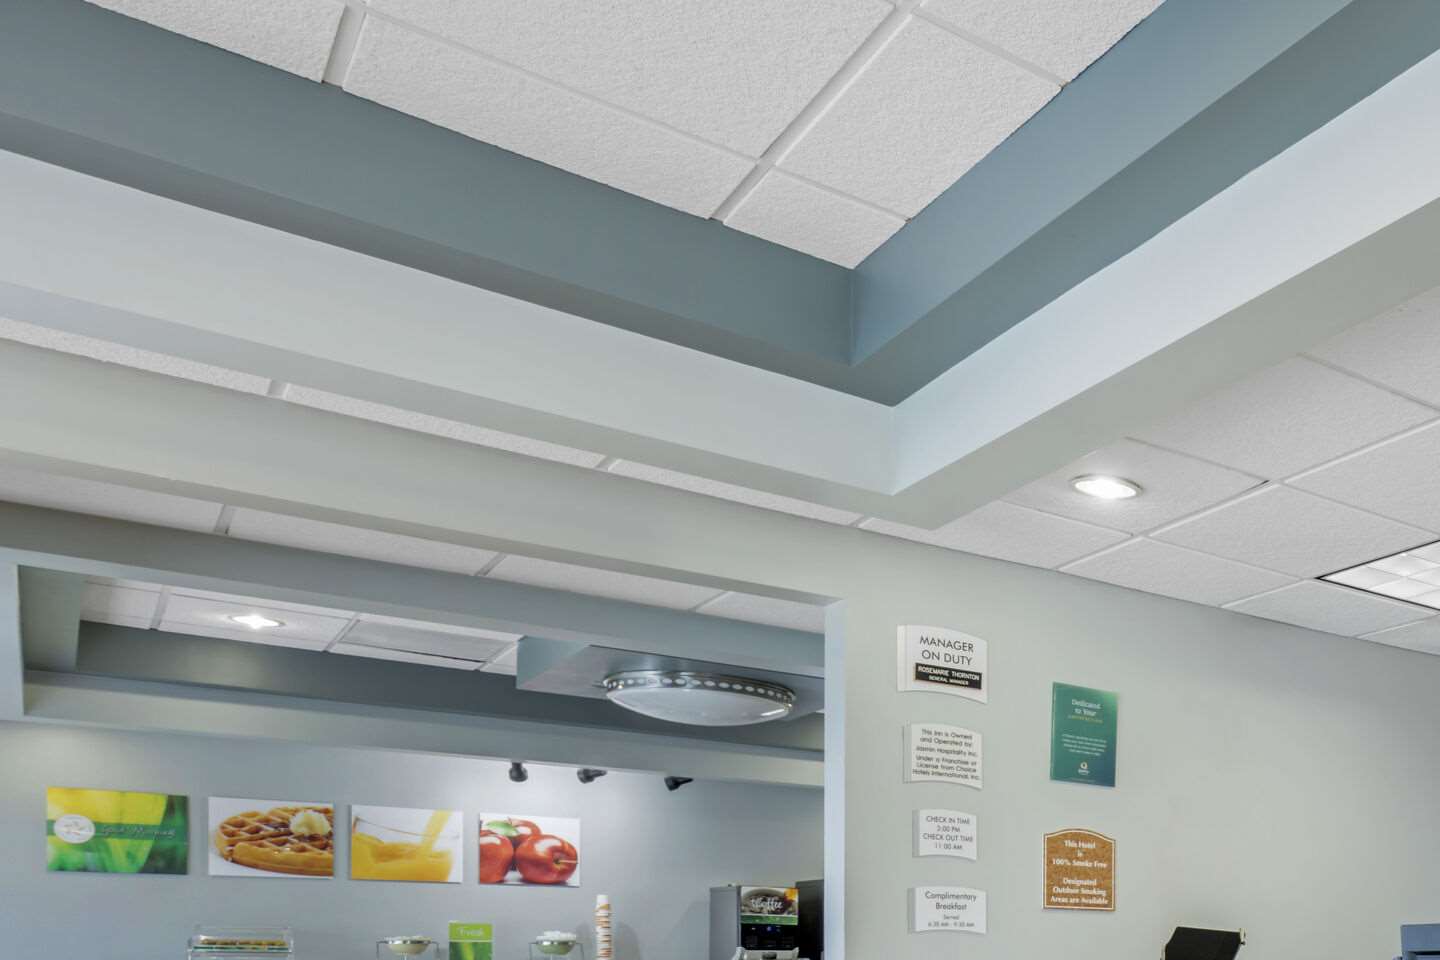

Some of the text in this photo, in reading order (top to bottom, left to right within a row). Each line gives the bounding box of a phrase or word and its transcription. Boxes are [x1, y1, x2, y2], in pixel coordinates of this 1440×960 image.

[920, 635, 973, 652] MANAGER
[922, 650, 972, 665] ON DUTY
[951, 670, 980, 680] THORNTON
[922, 728, 932, 736] This
[951, 732, 972, 740] Owned
[934, 738, 962, 746] Operated
[937, 748, 966, 756] Hospitality
[942, 757, 969, 765] Franchise
[926, 815, 947, 823] CHECK
[945, 834, 959, 842] OUT
[960, 835, 973, 843] TIME
[1064, 840, 1096, 849] This Hotel
[1052, 858, 1071, 866] 100%
[1063, 877, 1097, 886] Designated
[925, 890, 977, 902] Complimentary
[1081, 888, 1106, 896] Smoking
[1081, 897, 1108, 905] Available
[936, 902, 967, 911] Breakfast
